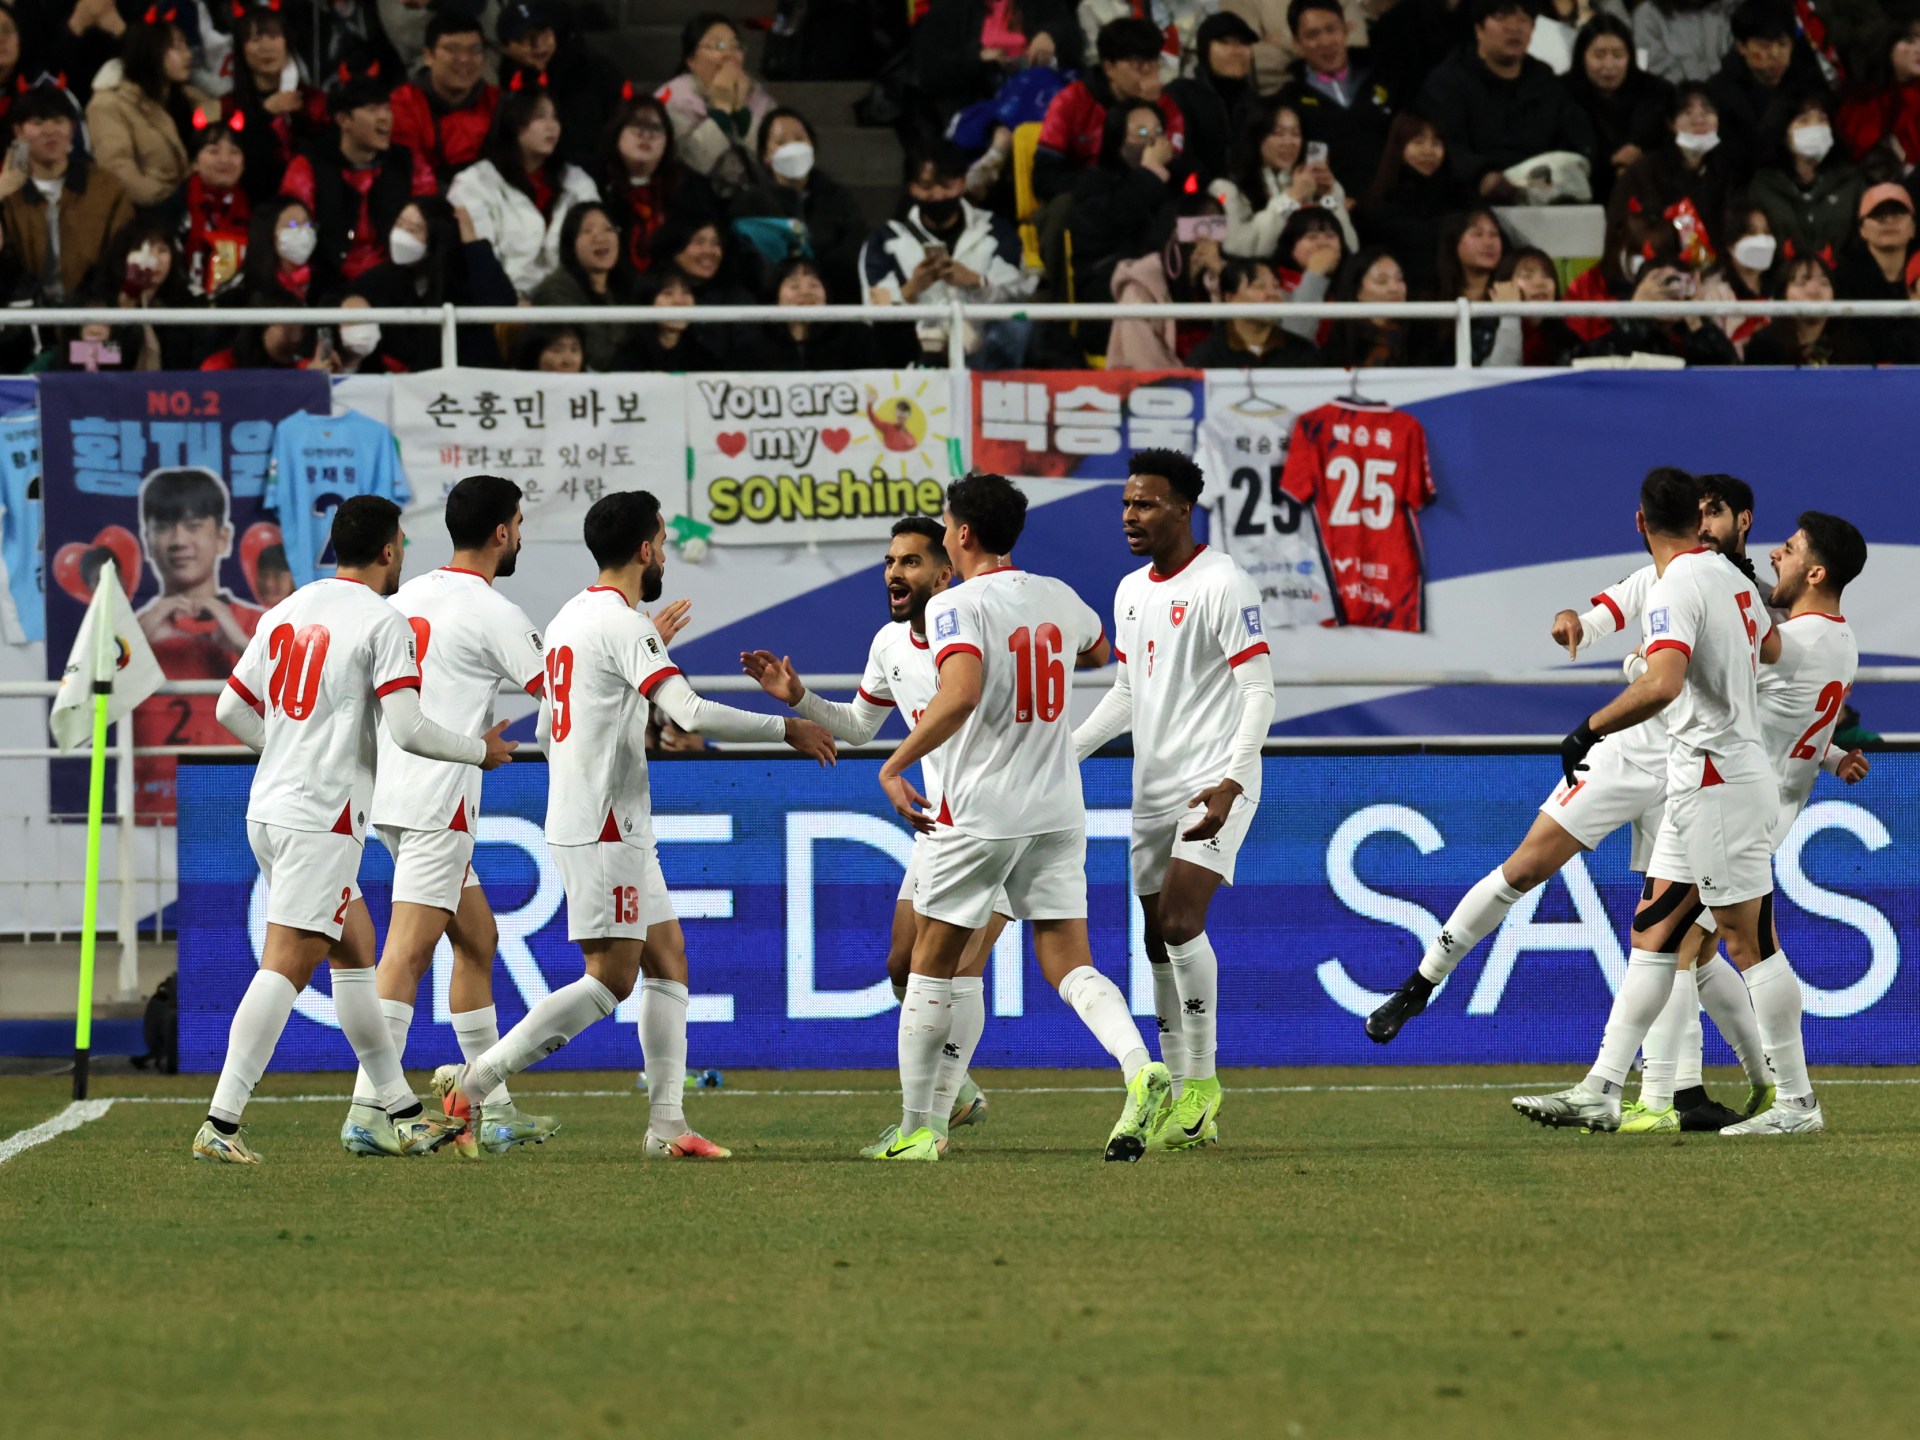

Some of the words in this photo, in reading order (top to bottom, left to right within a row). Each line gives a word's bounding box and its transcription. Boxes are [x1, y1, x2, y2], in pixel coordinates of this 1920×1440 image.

[147, 389, 221, 416] NO.2
[425, 389, 546, 430] 손흥민
[568, 388, 647, 428] 바보
[698, 380, 782, 420] You
[788, 381, 858, 418] are
[439, 443, 545, 469] 바라보고
[557, 442, 636, 469] 있어도
[749, 427, 817, 467] my
[556, 476, 606, 503] 사람
[708, 466, 945, 524] SONshine
[1230, 465, 1303, 537] 25
[1325, 456, 1397, 531] 25
[1147, 640, 1155, 679] 3
[1734, 591, 1758, 678] 5
[268, 622, 331, 721] 20
[545, 645, 574, 743] 13
[1008, 622, 1065, 724] 16
[163, 699, 193, 745] 2
[1789, 680, 1852, 762] 2
[612, 885, 639, 925] 13
[1316, 800, 1900, 1018] SAS
